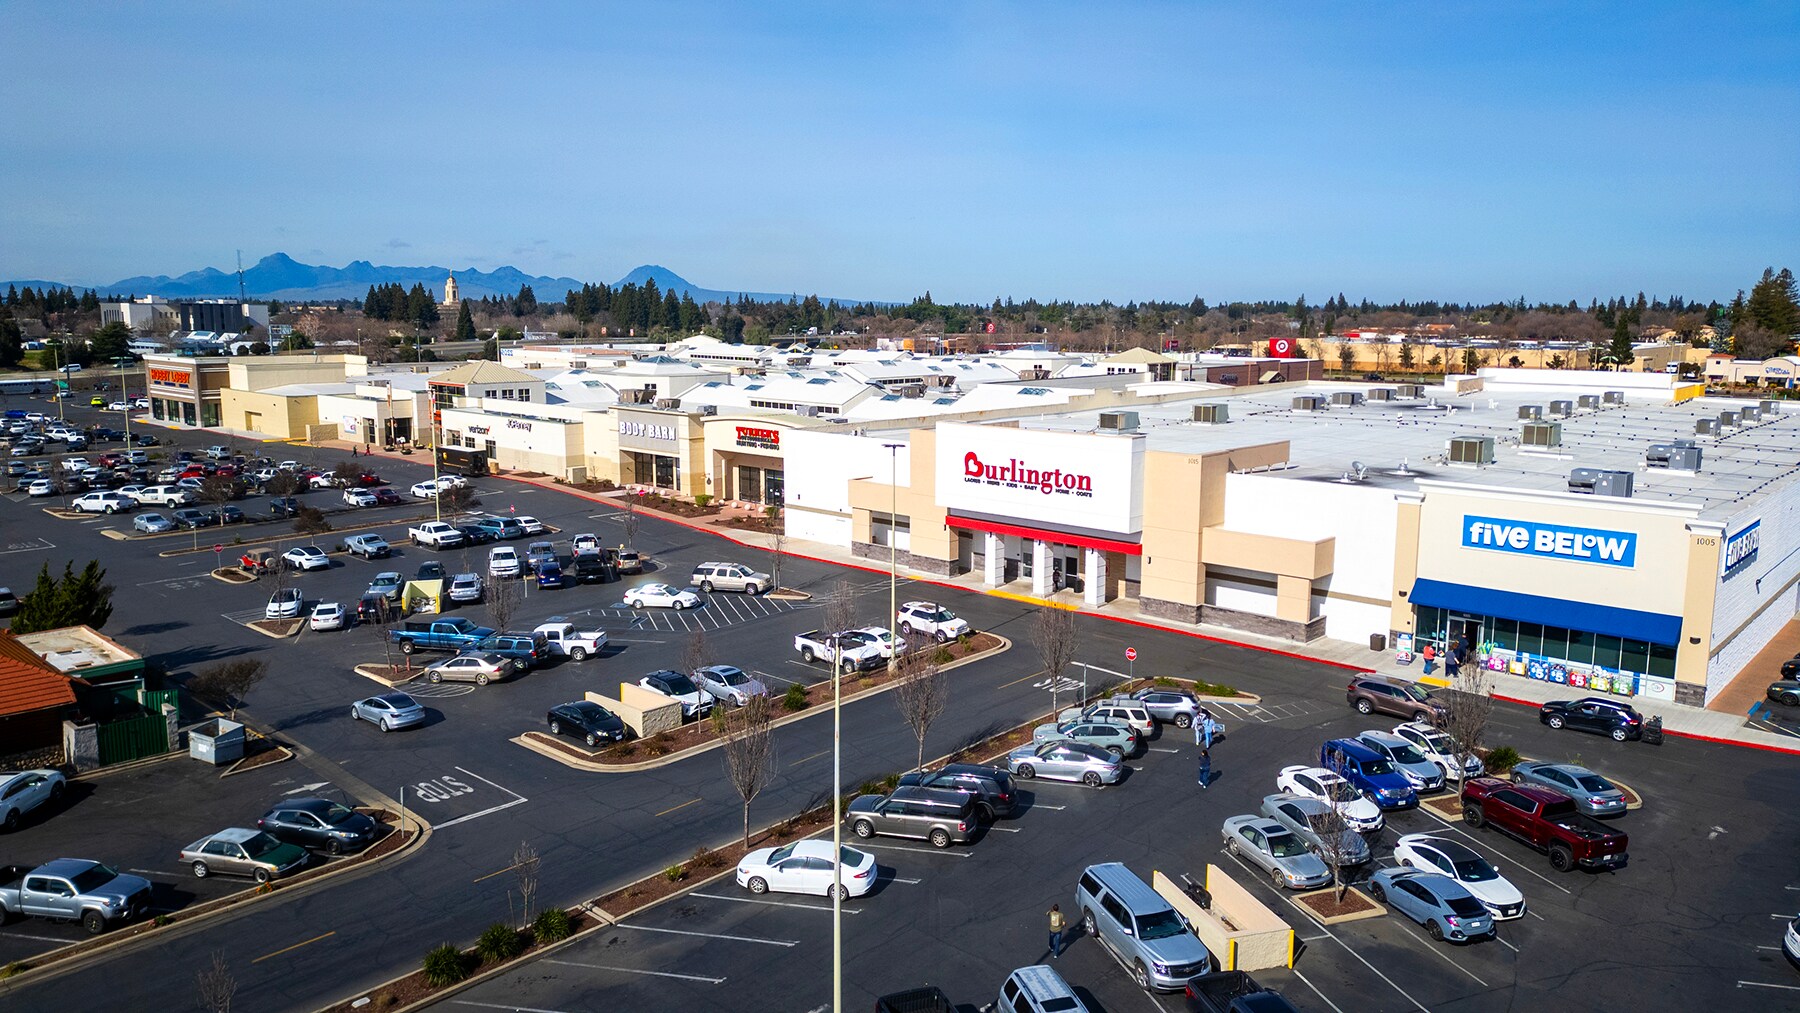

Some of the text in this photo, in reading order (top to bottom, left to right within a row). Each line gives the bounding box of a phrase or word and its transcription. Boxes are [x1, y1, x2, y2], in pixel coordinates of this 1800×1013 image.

[468, 425, 489, 435] verizon
[619, 421, 677, 441] BOOT BARN
[964, 451, 1092, 495] Burlington
[1469, 521, 1629, 561] five BELOW
[1696, 537, 1716, 547] 1005
[411, 775, 474, 803] STOP
